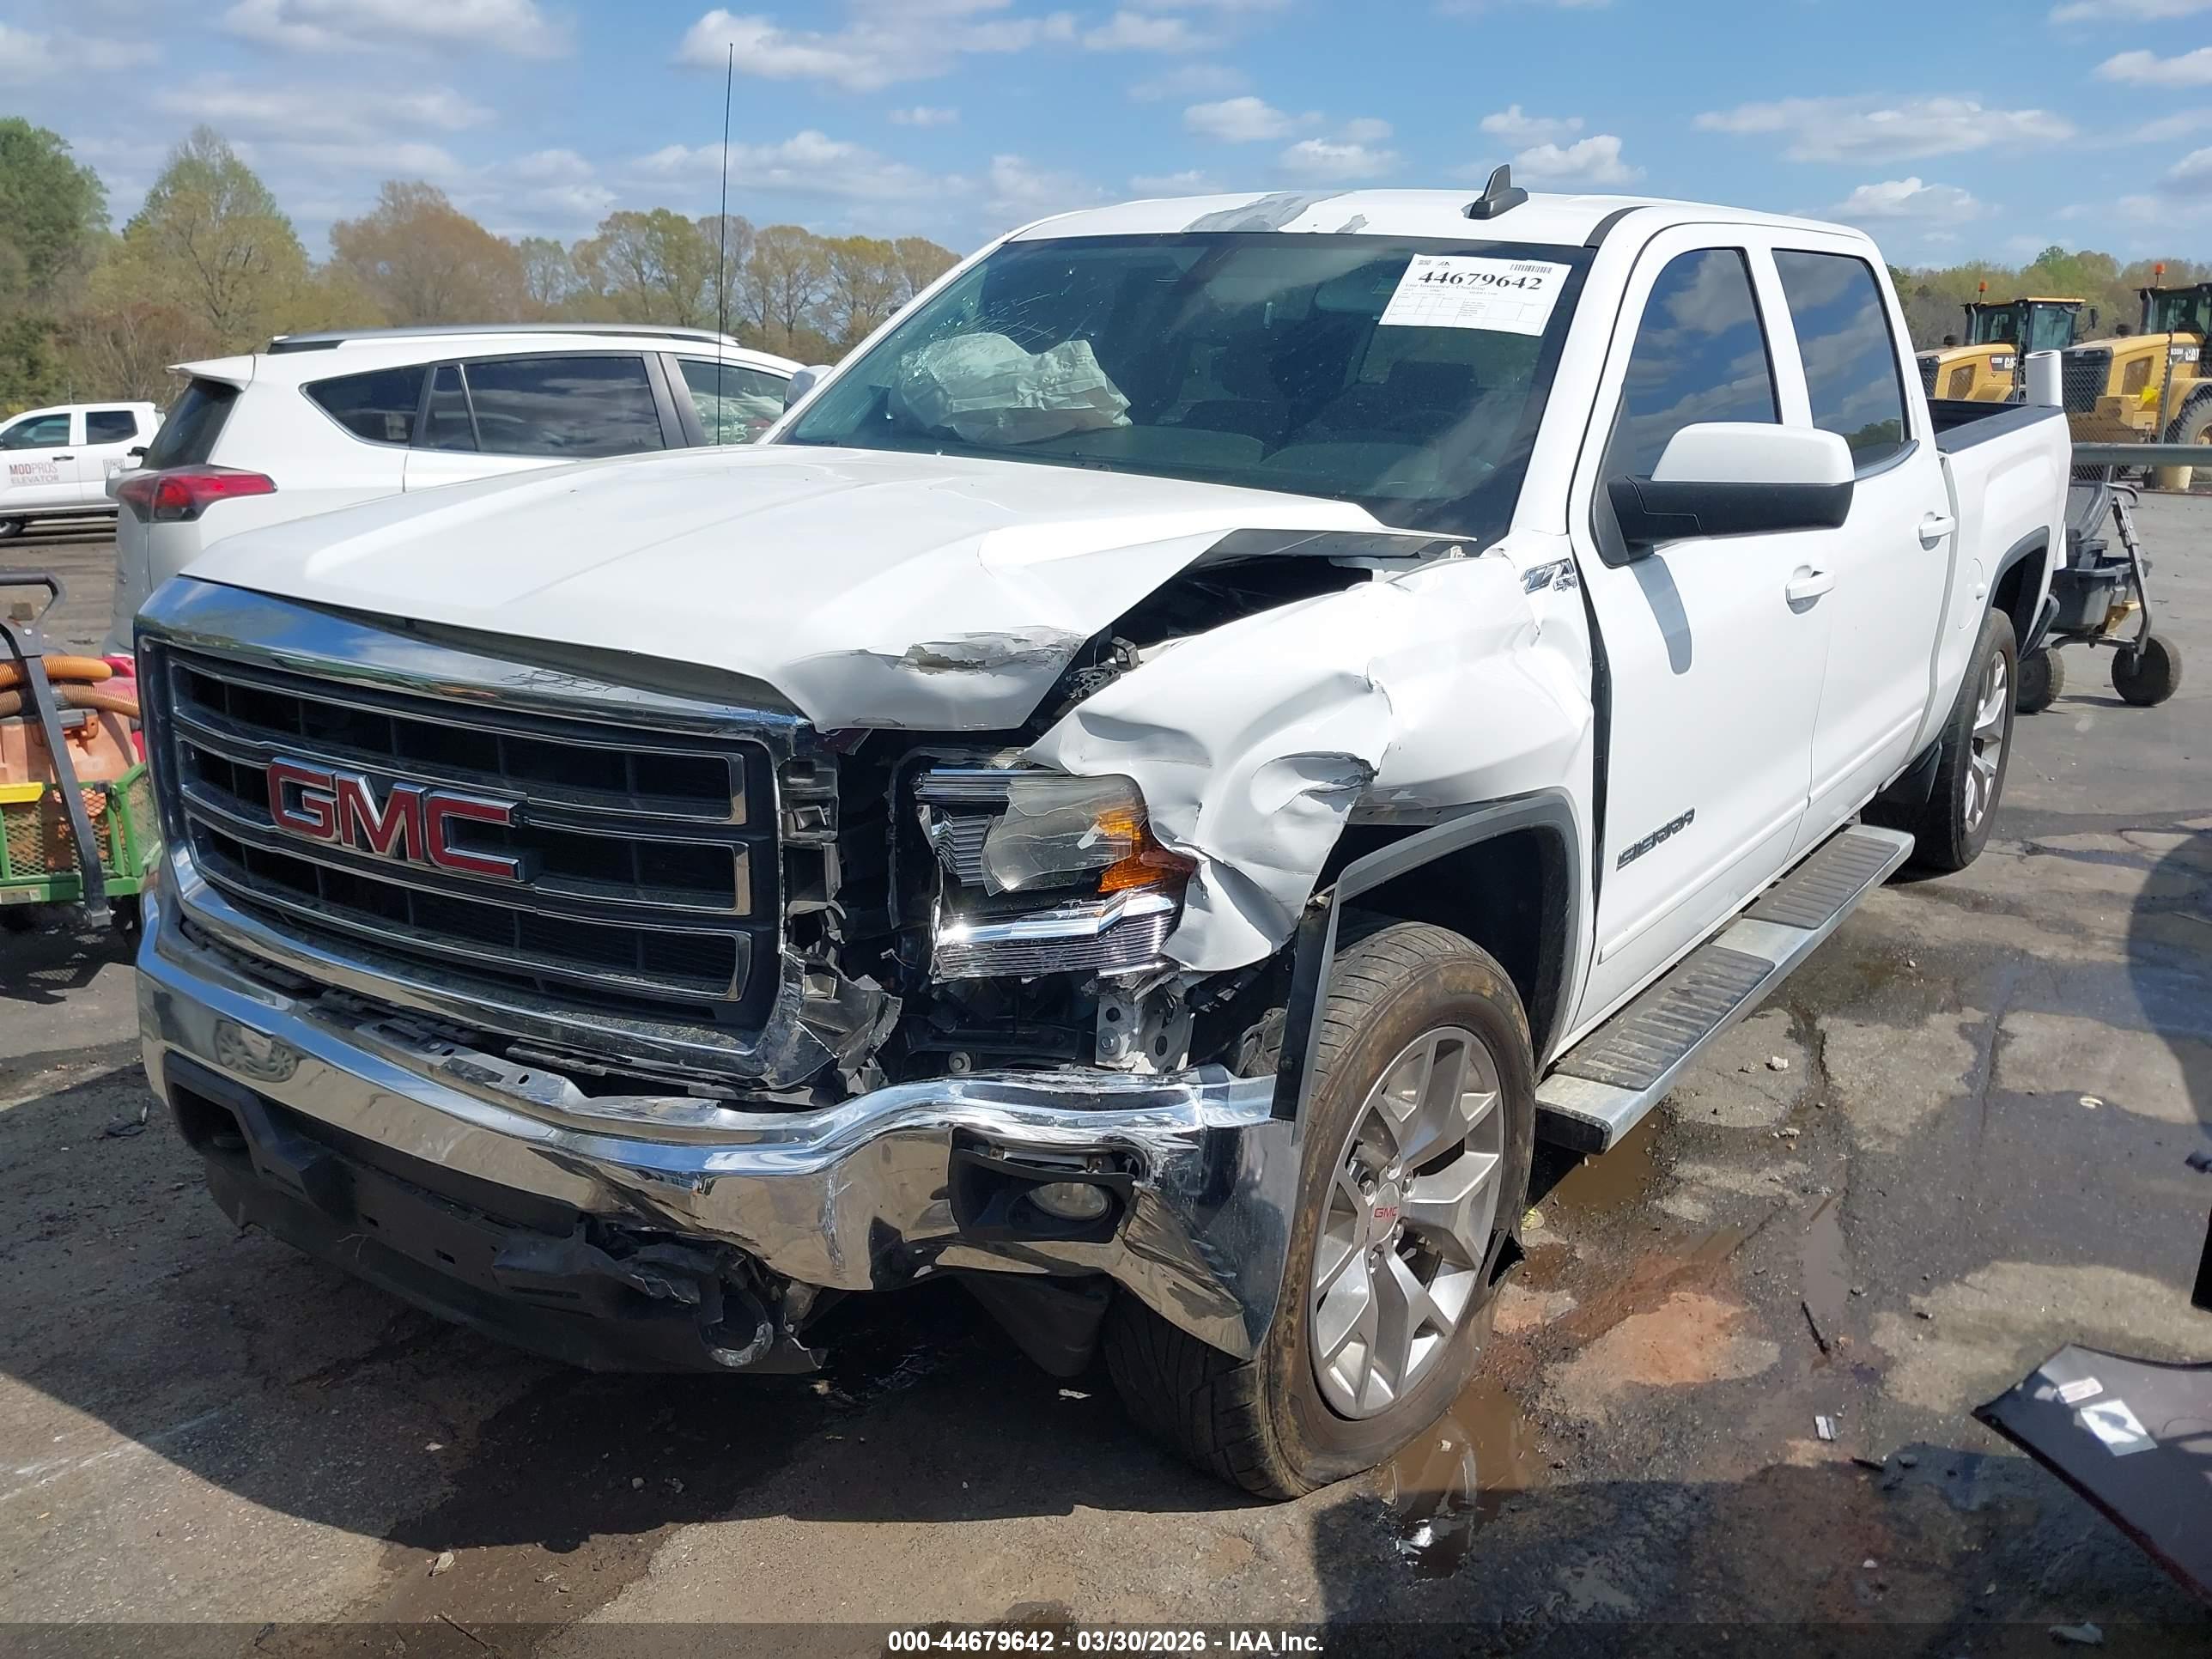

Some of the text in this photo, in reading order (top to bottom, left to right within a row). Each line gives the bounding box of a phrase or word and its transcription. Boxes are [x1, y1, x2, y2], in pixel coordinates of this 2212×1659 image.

[1418, 271, 1543, 290] 44679642
[9, 462, 58, 476] MODPROS
[11, 474, 59, 484] ELEVATOR
[266, 757, 524, 883] GMC
[1616, 805, 1696, 872] SIERRA
[1373, 1206, 1399, 1218] GMC
